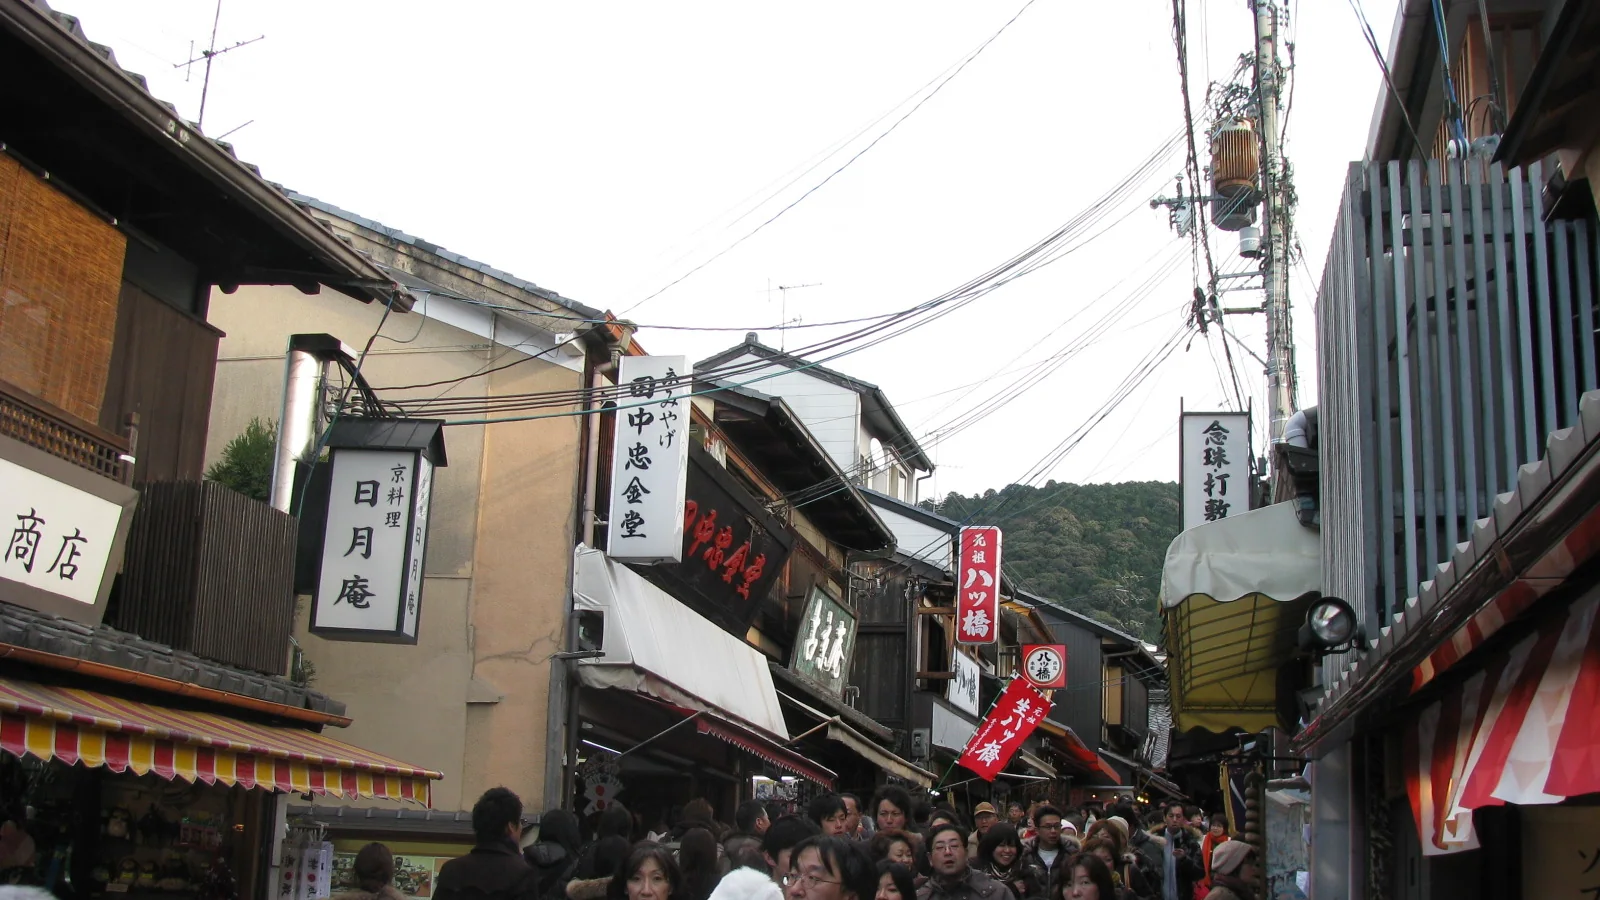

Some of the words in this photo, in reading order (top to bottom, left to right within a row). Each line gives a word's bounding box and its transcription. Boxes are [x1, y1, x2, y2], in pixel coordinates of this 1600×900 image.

[620, 375, 655, 539] 田中忠金堂
[383, 463, 407, 528] 京料理
[4, 508, 88, 581] 商店
[333, 479, 381, 609] 日月庵
[971, 533, 987, 564] 元祖
